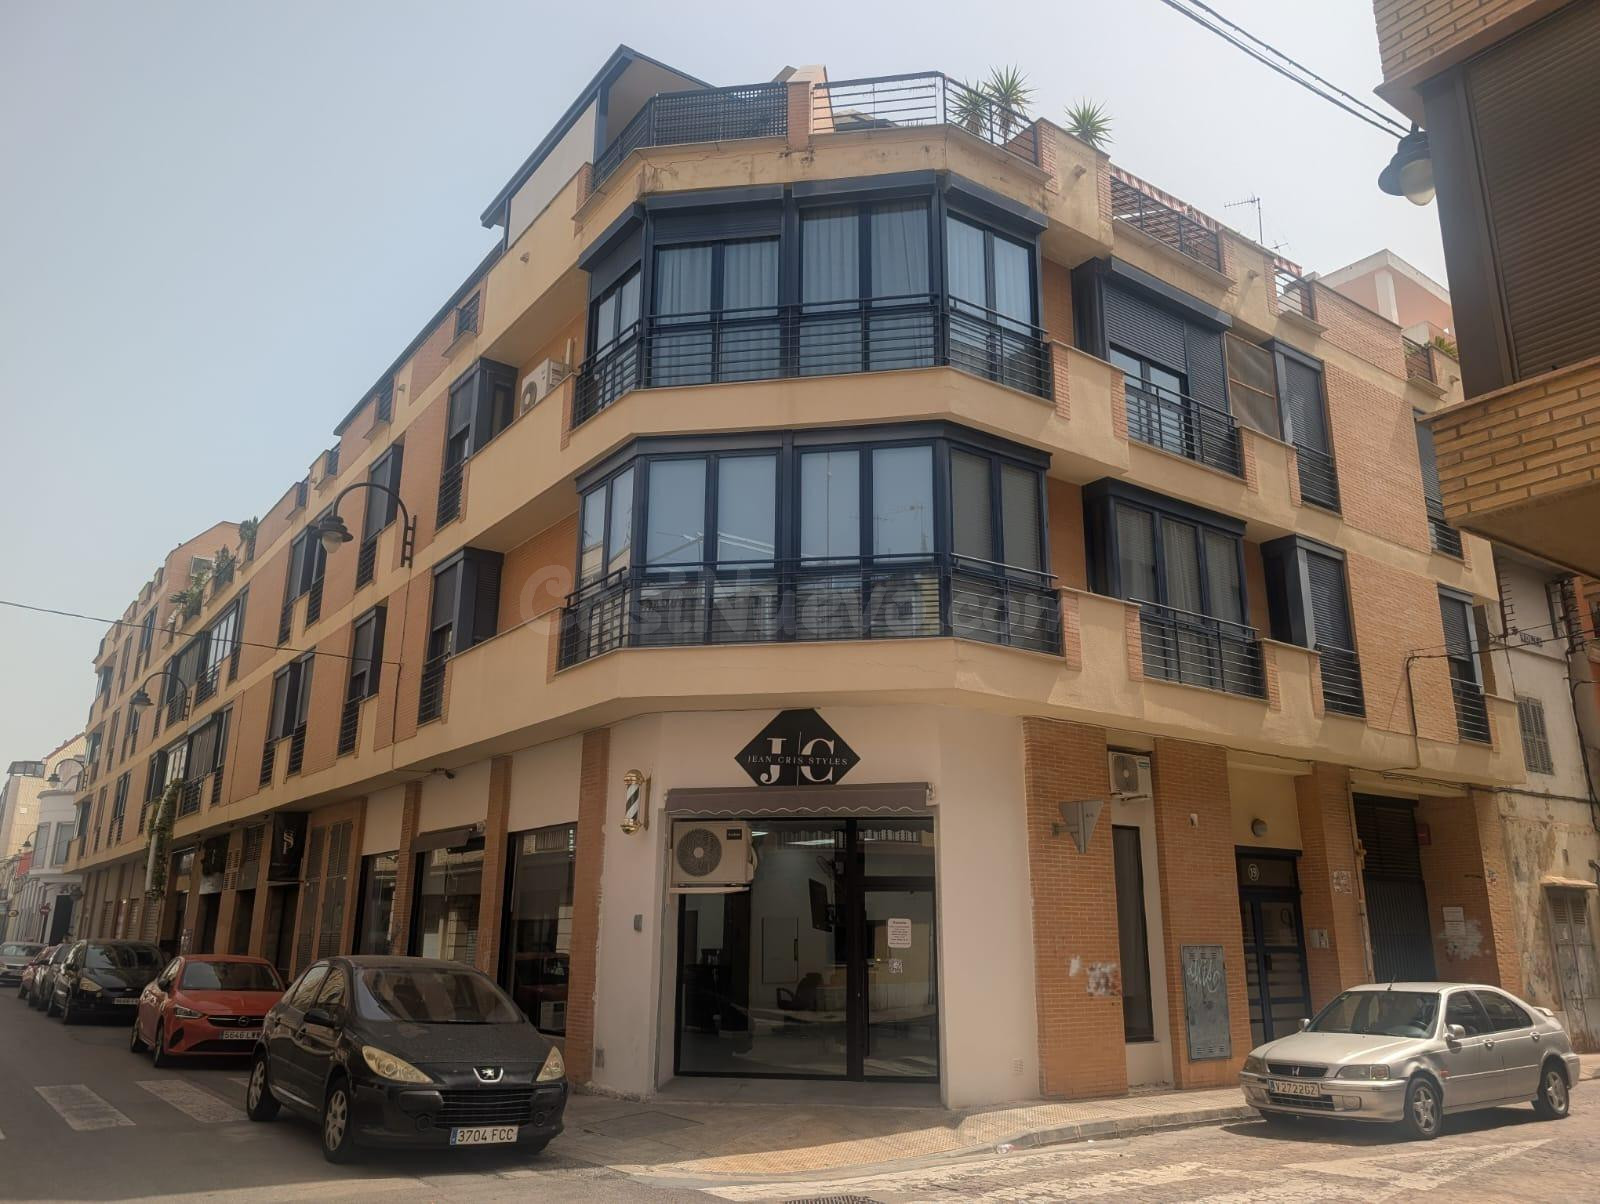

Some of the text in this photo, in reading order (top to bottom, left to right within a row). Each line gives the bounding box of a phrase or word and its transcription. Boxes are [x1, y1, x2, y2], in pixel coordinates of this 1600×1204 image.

[748, 755, 772, 763] JEAN
[808, 757, 848, 766] STYLES
[458, 1128, 514, 1142] 3704 FCC
